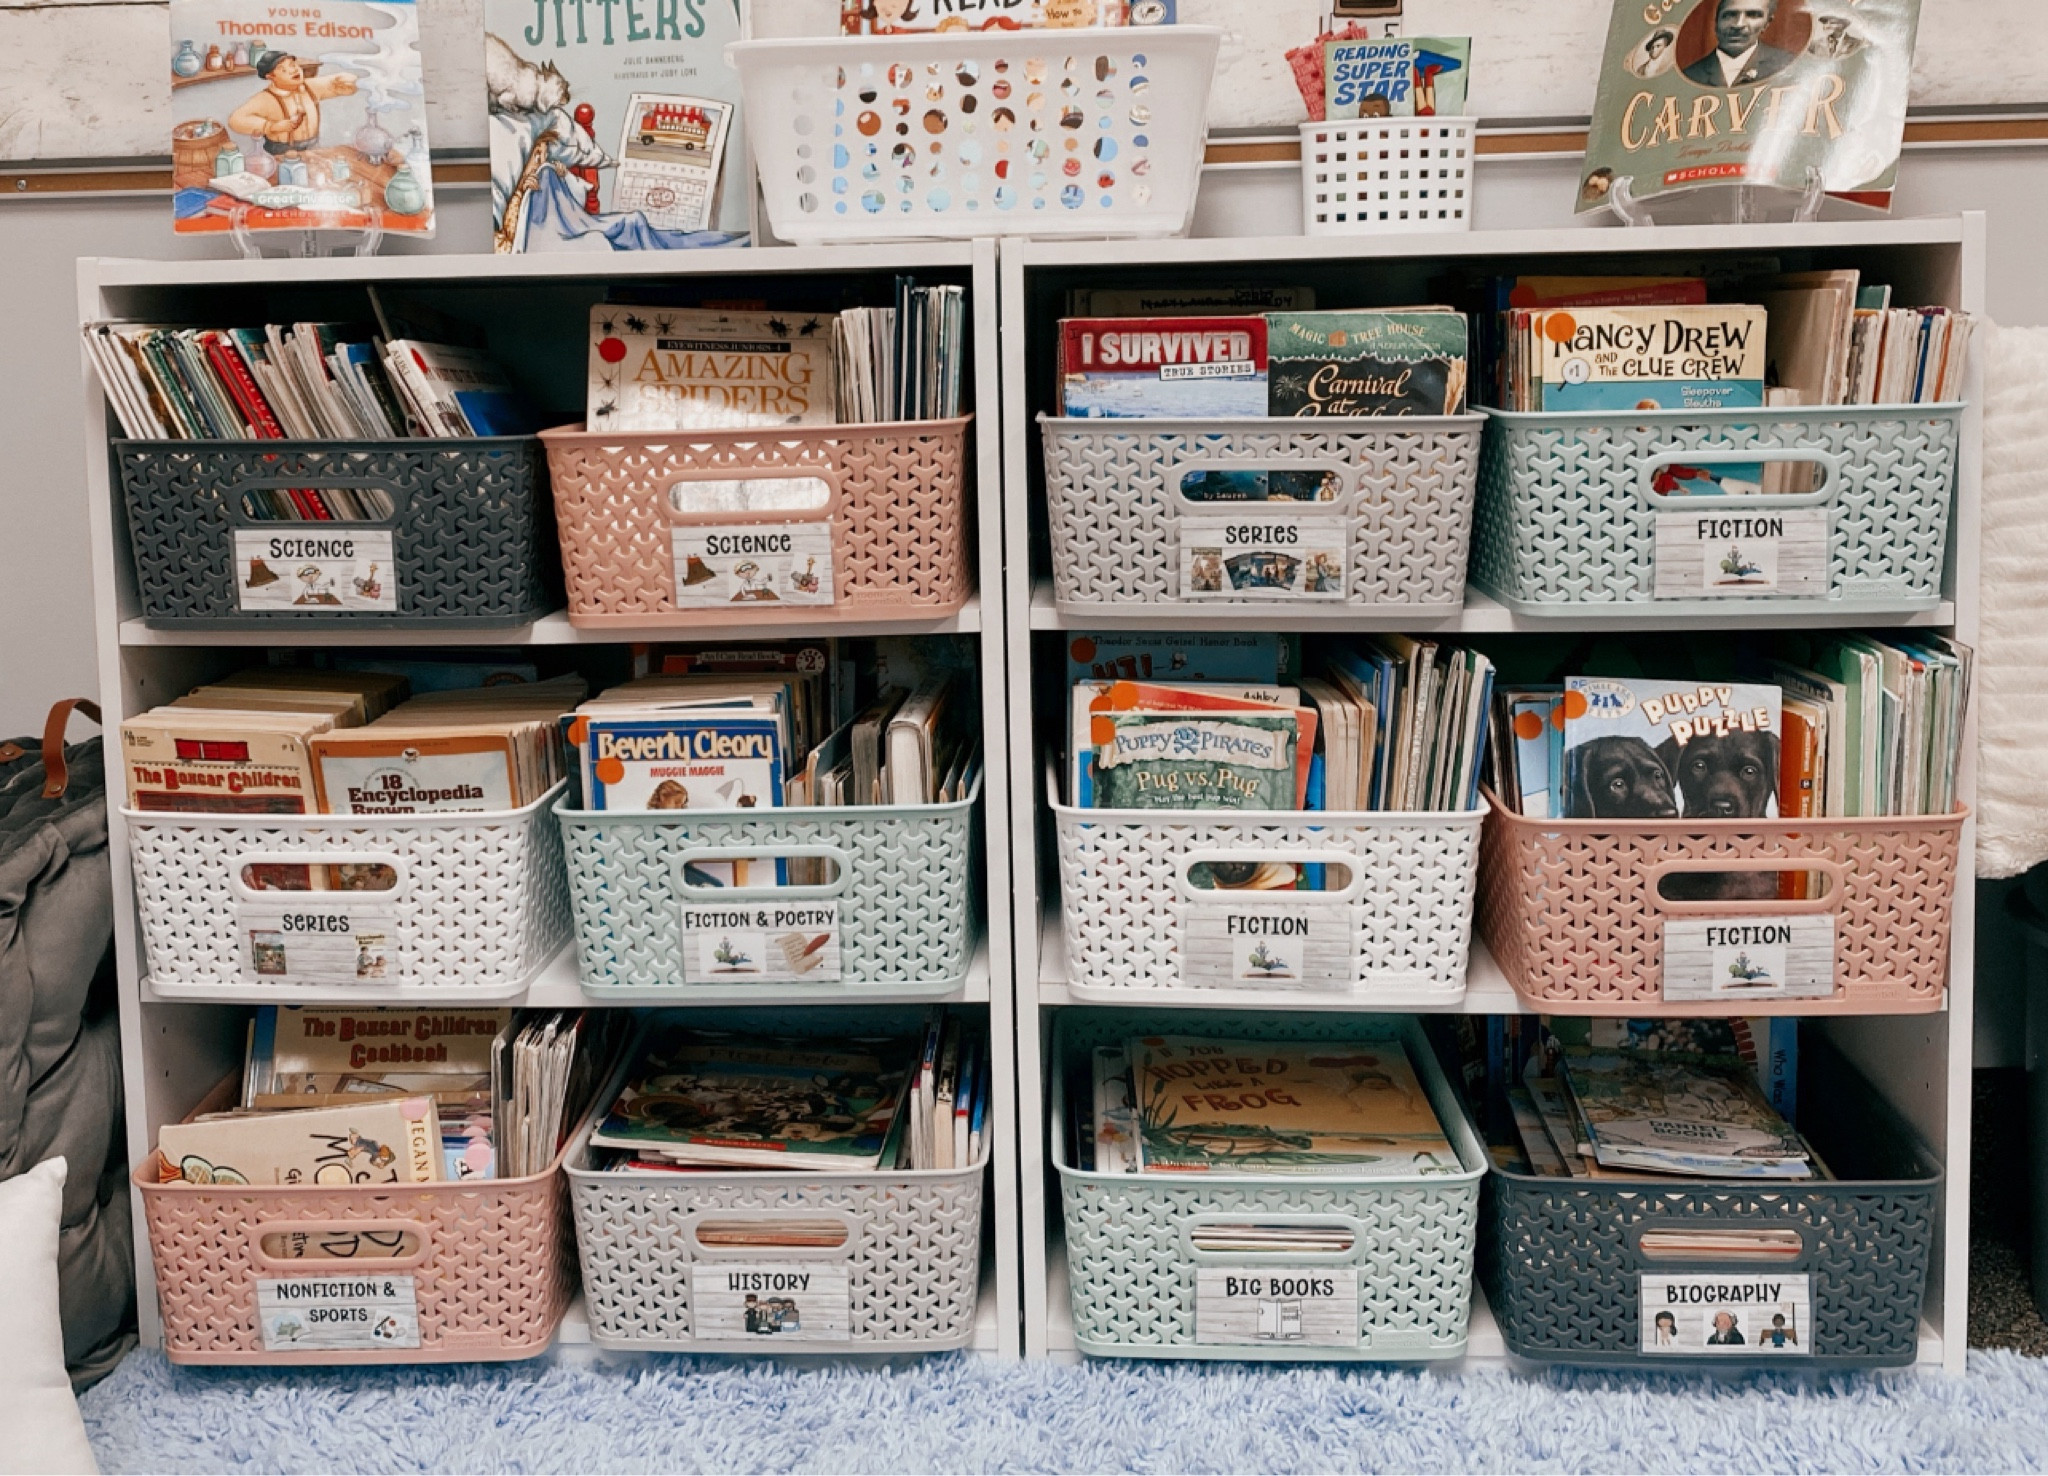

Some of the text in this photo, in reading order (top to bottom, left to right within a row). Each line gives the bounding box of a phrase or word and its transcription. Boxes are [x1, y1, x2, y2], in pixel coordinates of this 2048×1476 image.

[268, 7, 322, 18] YOUNG
[217, 20, 374, 38] Thomas Edison
[524, 0, 706, 48] JITTERS
[623, 55, 643, 66] JULIE
[1333, 43, 1411, 62] READING
[1333, 60, 1411, 82] SUPER
[1334, 79, 1411, 106] STAR
[1620, 73, 1847, 152] CARVER
[257, 193, 295, 204] Great
[1289, 322, 1427, 345] MAGIC TREE HOUSE
[1663, 319, 1753, 357] DREW
[1082, 331, 1251, 364] I SURVIVED
[1594, 352, 1618, 364] AND
[632, 348, 815, 385] AMAZING
[1163, 364, 1252, 377] TRUE STORIES
[1622, 357, 1675, 377] CLUE
[1681, 354, 1746, 380] CREW
[1307, 364, 1413, 401] Carnival
[1680, 386, 1733, 398] Sleepover
[638, 384, 810, 415] SPIDERS
[1327, 398, 1357, 414] at
[1225, 525, 1298, 545] SERIES
[1698, 518, 1783, 539] FICTION
[269, 537, 355, 559] SCIENCE
[706, 532, 793, 556] SCIENCE
[1095, 636, 1131, 646] Theodor
[1200, 635, 1229, 646] Honor
[1234, 635, 1258, 646] Book
[804, 655, 816, 670] 2
[1640, 686, 1732, 726] PUPPY
[1668, 707, 1770, 748] PUZZLE
[600, 731, 773, 765] Beverly Cleary
[1115, 732, 1173, 754] PUPPY
[1201, 731, 1274, 759] PIRATES
[134, 767, 302, 793] The Boxcar Children
[381, 774, 402, 790] 18
[650, 765, 725, 778] MUGGIE MAGGIE
[1136, 768, 1260, 798] Pug vs. Pug
[348, 785, 484, 805] Encyclopedia
[282, 914, 350, 932] SERIES
[685, 910, 835, 929] FICTION & POETRY
[1227, 915, 1309, 935] FICTION
[1707, 925, 1792, 946] FICTION
[303, 1016, 499, 1042] The Boxcar Children
[350, 1043, 448, 1069] Cookbook
[1773, 1049, 1787, 1076] Who
[1182, 1088, 1302, 1112] FROG
[1651, 1120, 1717, 1132] DANIEL
[1653, 1127, 1728, 1140] BOONE
[277, 1281, 396, 1300] NONFICTION &
[728, 1273, 810, 1291] HISTORY
[1226, 1276, 1334, 1297] BIG BOOKS
[1666, 1283, 1781, 1304] BIOGRAPHY
[309, 1308, 368, 1323] SPORTS
